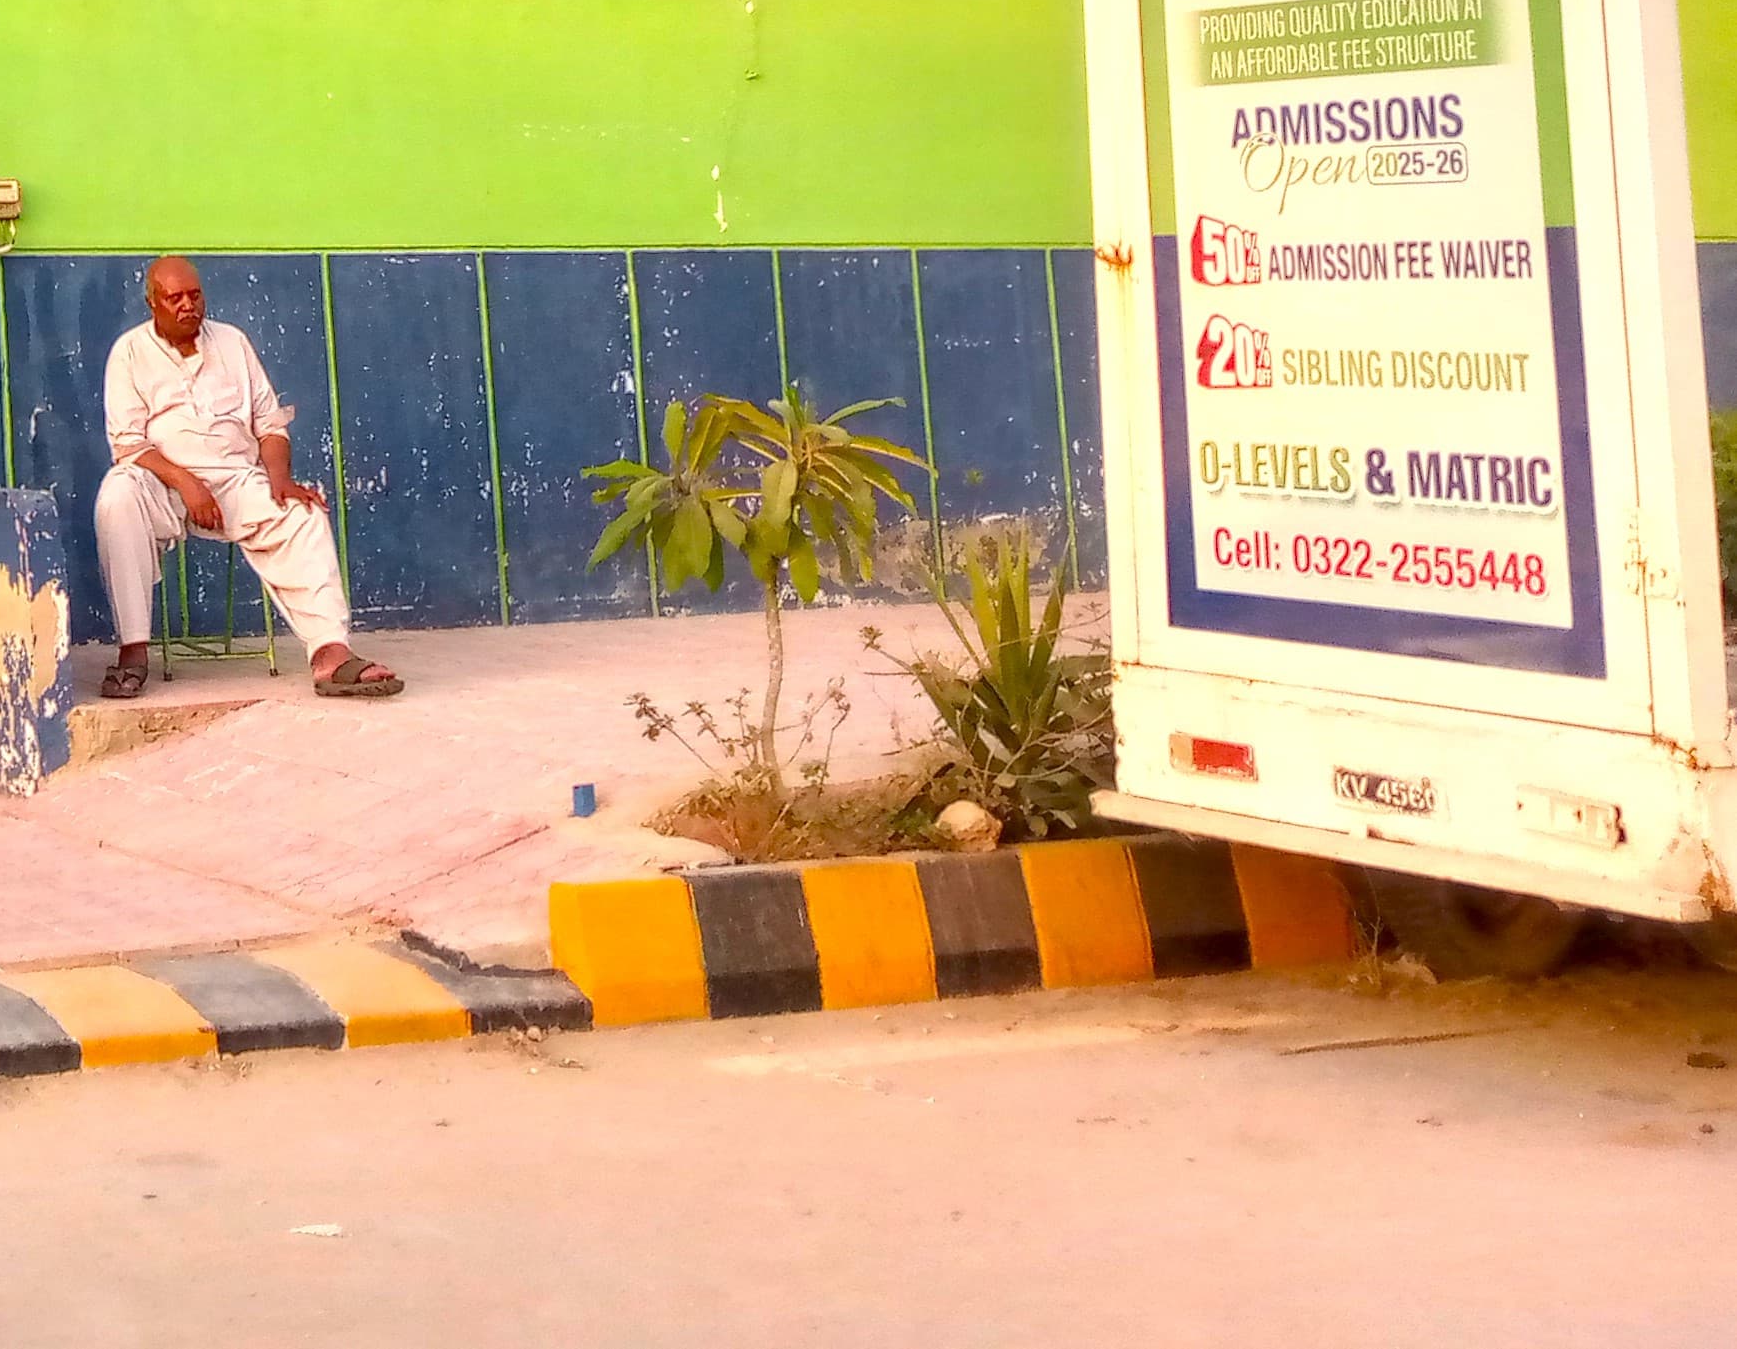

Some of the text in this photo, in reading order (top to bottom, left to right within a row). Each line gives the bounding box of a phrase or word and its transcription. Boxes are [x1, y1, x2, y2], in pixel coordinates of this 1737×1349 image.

[1199, 8, 1285, 45] PROVIDING
[1289, 1, 1357, 36] QUALITY
[1211, 29, 1477, 79] AN AFFORDABLE FEE STRUCTURE
[1231, 93, 1464, 148] ADMISSIONS
[1239, 133, 1463, 215] Open 2025-26
[1190, 214, 1533, 286] 50% ADMISSION FEE WAIVER
[1196, 313, 1529, 392] 20% SIBLING DISCOUNT
[1200, 440, 1553, 507] O-LEVELS & MATRIC
[1213, 526, 1546, 597] Cell: 0322-2555448
[1335, 772, 1368, 801] KV
